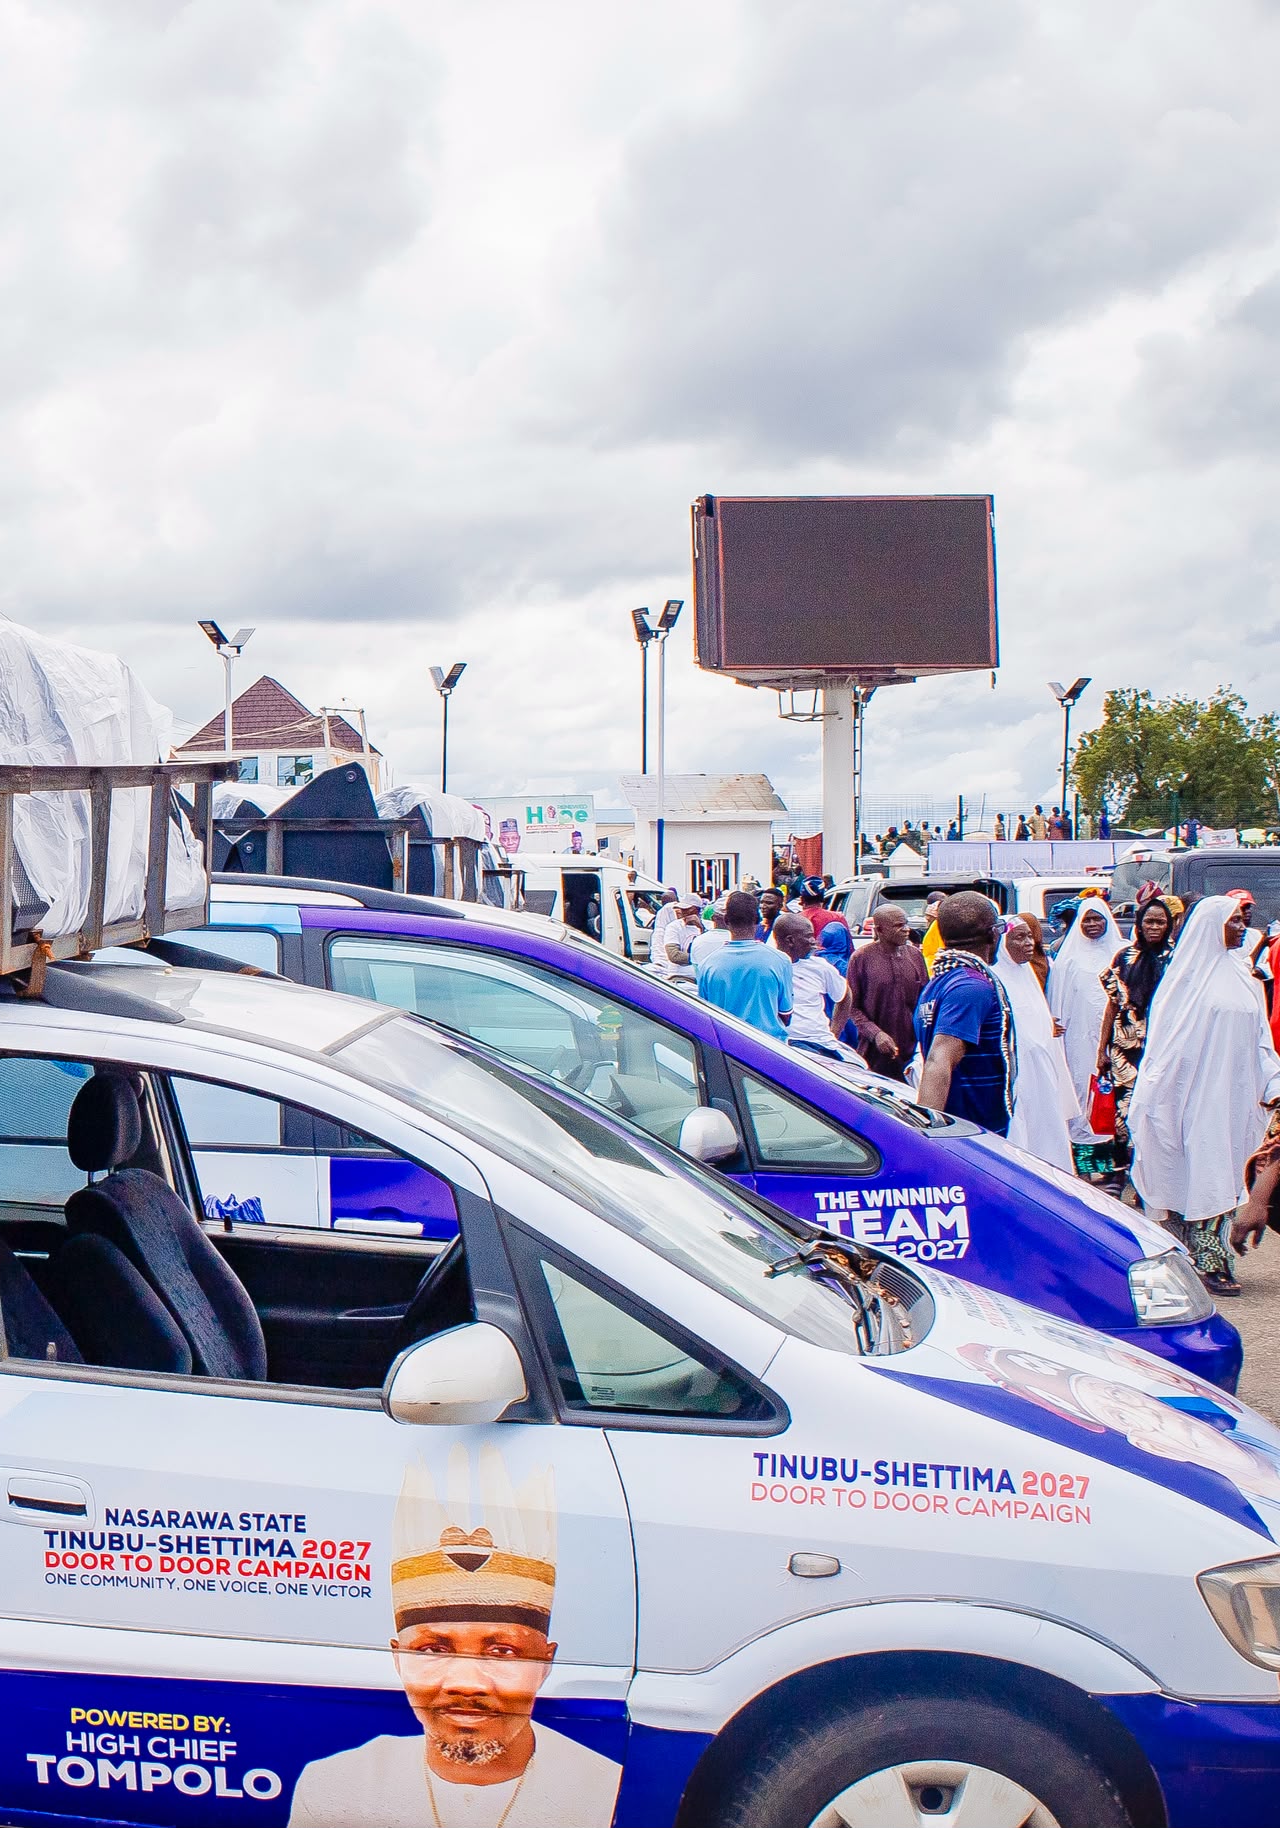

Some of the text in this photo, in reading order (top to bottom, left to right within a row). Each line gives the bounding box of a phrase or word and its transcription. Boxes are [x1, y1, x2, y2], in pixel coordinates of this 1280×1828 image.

[814, 1185, 965, 1210] THE WINNING
[816, 1206, 970, 1243] TEAM
[753, 1452, 1090, 1500] TINUBU-SHETTIMA 2027
[751, 1482, 1091, 1525] DOOR TO DOOR CAMPAIGN
[105, 1507, 306, 1534] NASARAWA STATE
[44, 1530, 372, 1561] TINUBU-SHETTIMA 2027
[44, 1551, 371, 1582] DOOR TO DOOR CAMPAIGN
[44, 1572, 372, 1599] ONE COMMUNITY, ONE VOICE, ONE VICTOR
[70, 1707, 231, 1734] POWERED BY:
[66, 1731, 237, 1762] HIGH CHIEF
[26, 1753, 282, 1800] TOMPOLO
